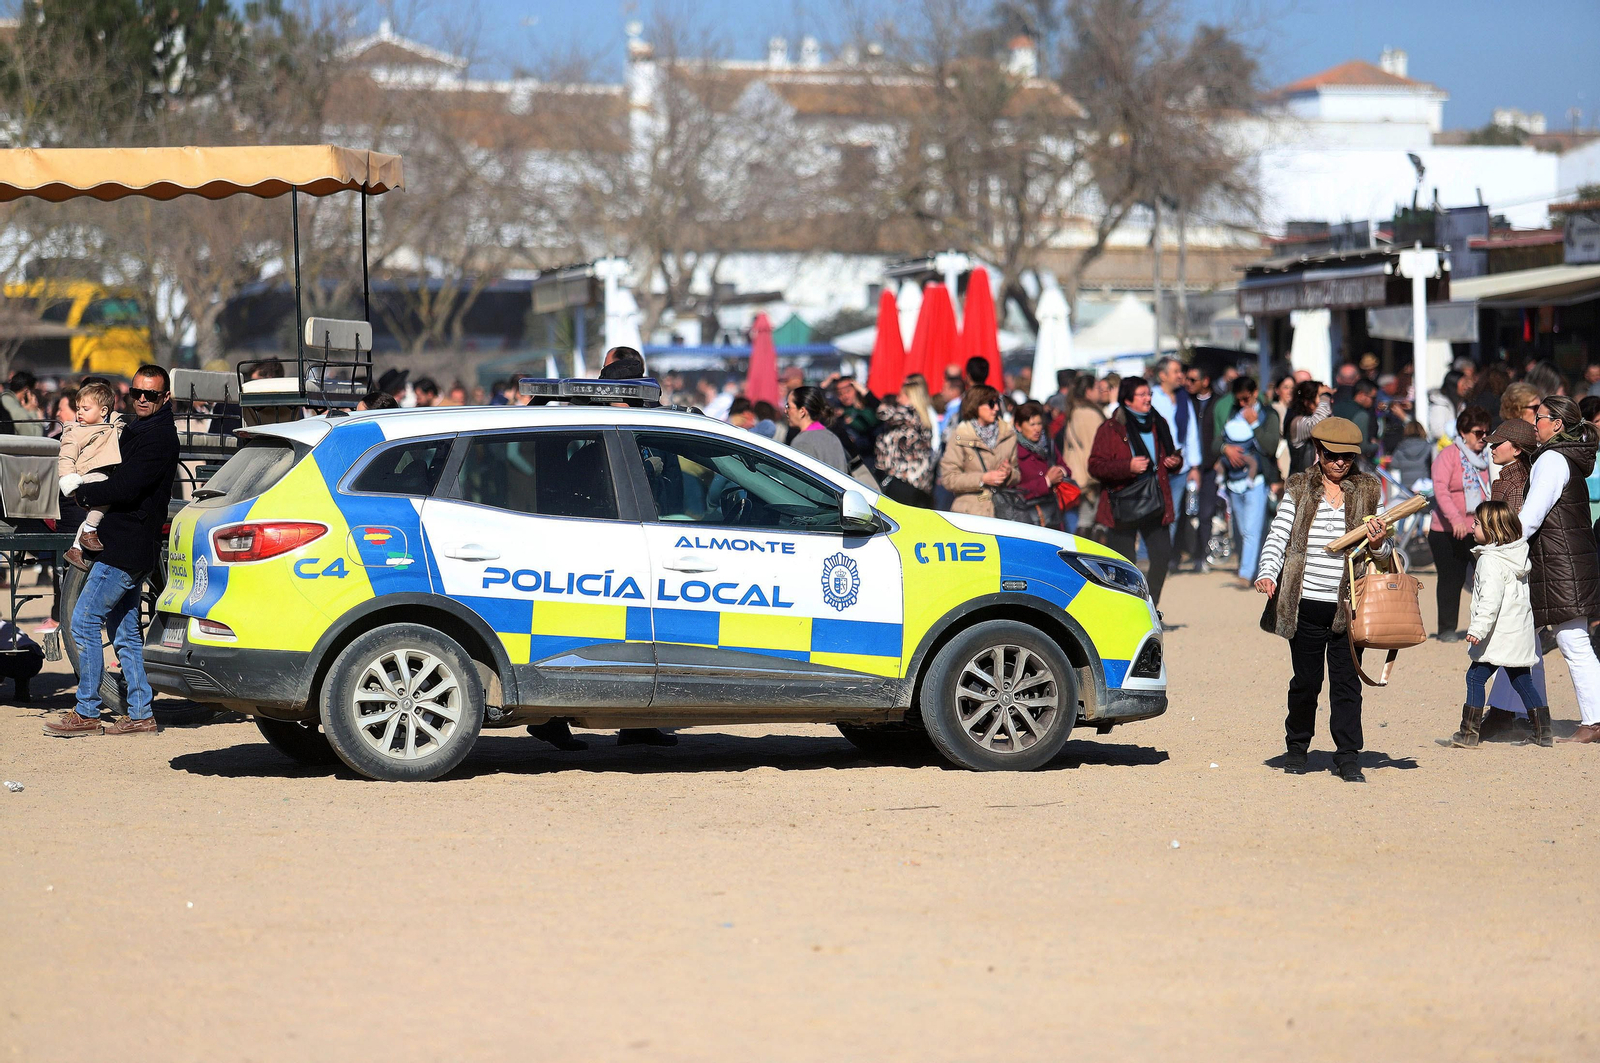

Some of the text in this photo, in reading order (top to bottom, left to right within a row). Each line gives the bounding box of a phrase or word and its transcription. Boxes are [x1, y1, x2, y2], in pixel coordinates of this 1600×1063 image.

[674, 535, 796, 555] ALMONTE
[932, 542, 986, 562] 112
[293, 557, 350, 579] C4
[482, 566, 795, 609] POLICÍA LOCAL
